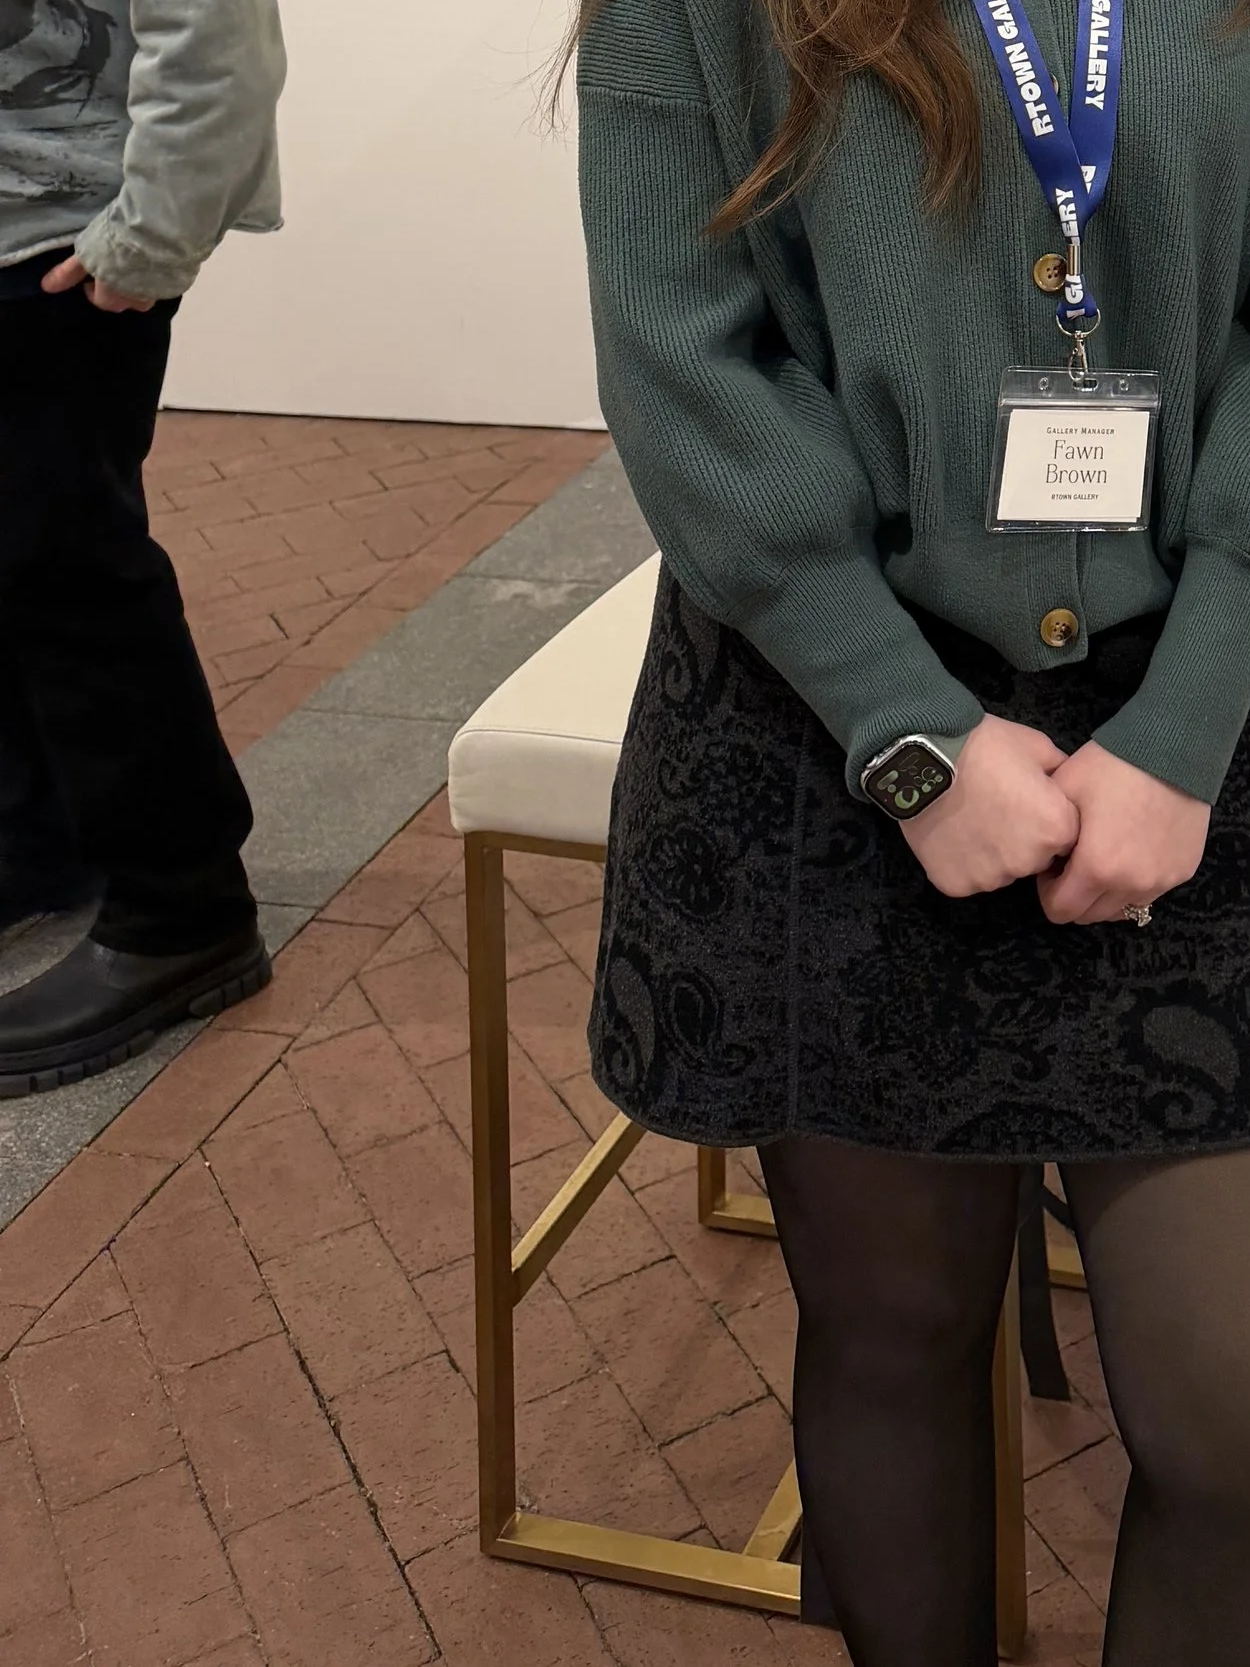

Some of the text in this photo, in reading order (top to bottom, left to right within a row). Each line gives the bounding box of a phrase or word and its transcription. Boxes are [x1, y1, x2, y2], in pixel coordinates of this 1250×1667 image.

[1005, 42, 1055, 137] RTOWN
[1046, 426, 1115, 435] GALLERY MANAGER
[1053, 439, 1105, 460] Fawn
[1045, 463, 1108, 484] Brown
